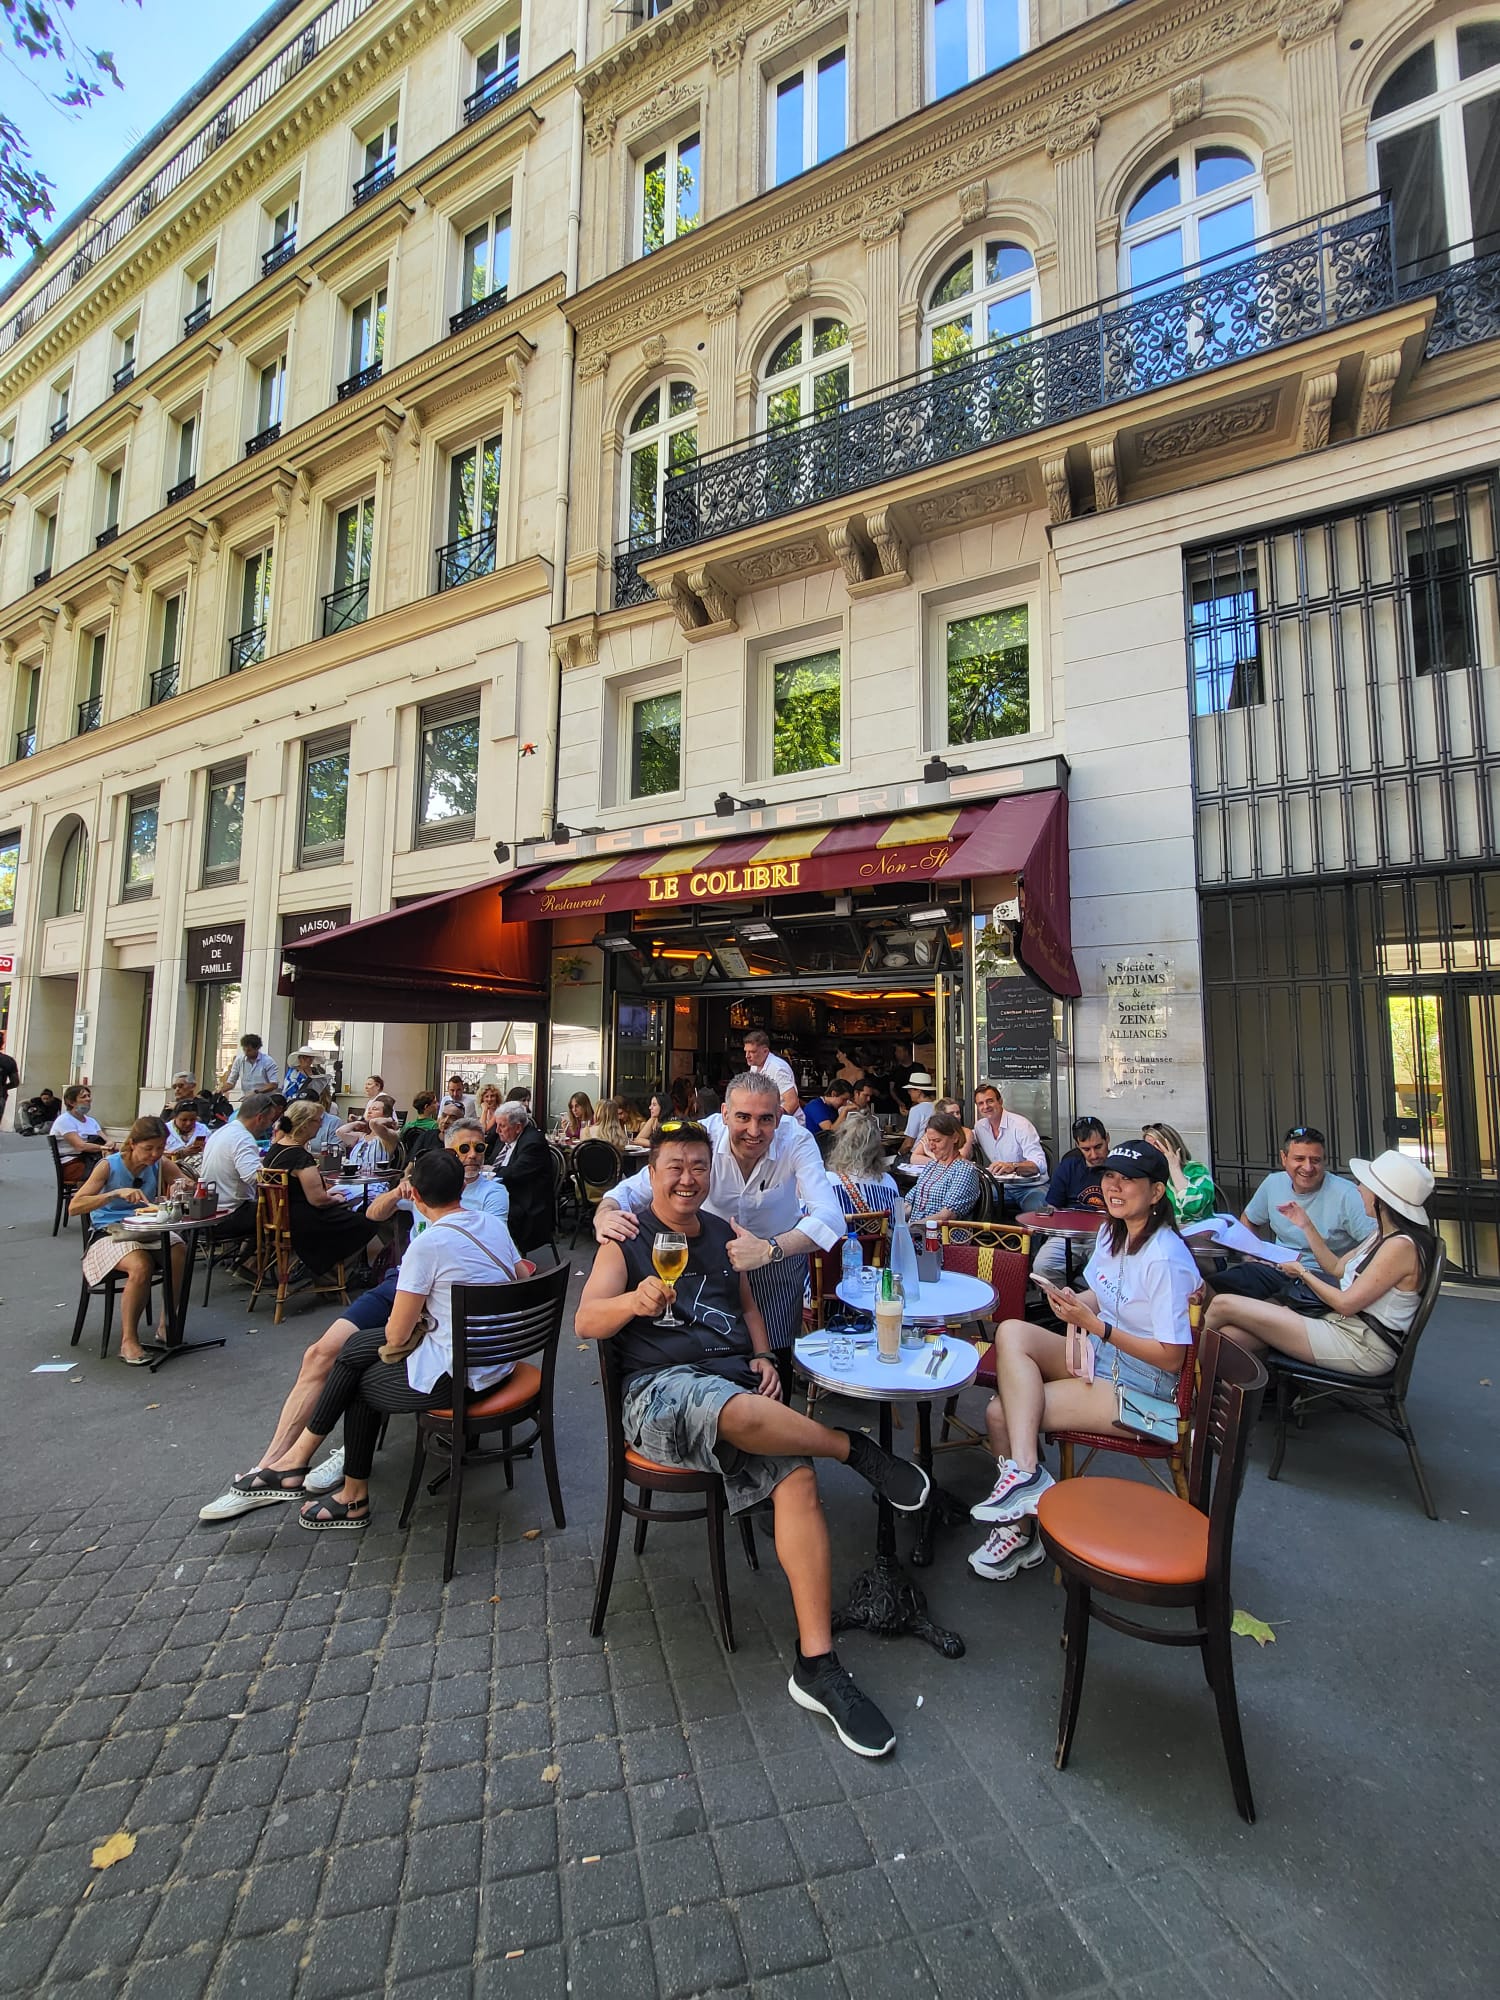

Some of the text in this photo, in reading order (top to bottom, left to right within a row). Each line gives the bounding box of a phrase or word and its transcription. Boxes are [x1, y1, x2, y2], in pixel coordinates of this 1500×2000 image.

[647, 862, 800, 901] LE COLIBRI
[540, 893, 607, 913] Restaurant
[299, 920, 337, 936] MAISON
[202, 933, 233, 948] MAISON
[211, 949, 222, 959] DE
[201, 962, 232, 974] FAMILLE
[1116, 961, 1155, 973] Société
[1107, 973, 1166, 986] MYDIAMS
[1132, 988, 1141, 998] &
[1118, 1001, 1157, 1012] Société
[1119, 1014, 1156, 1025] ZEINA
[1109, 1029, 1168, 1039] ALLIANCES
